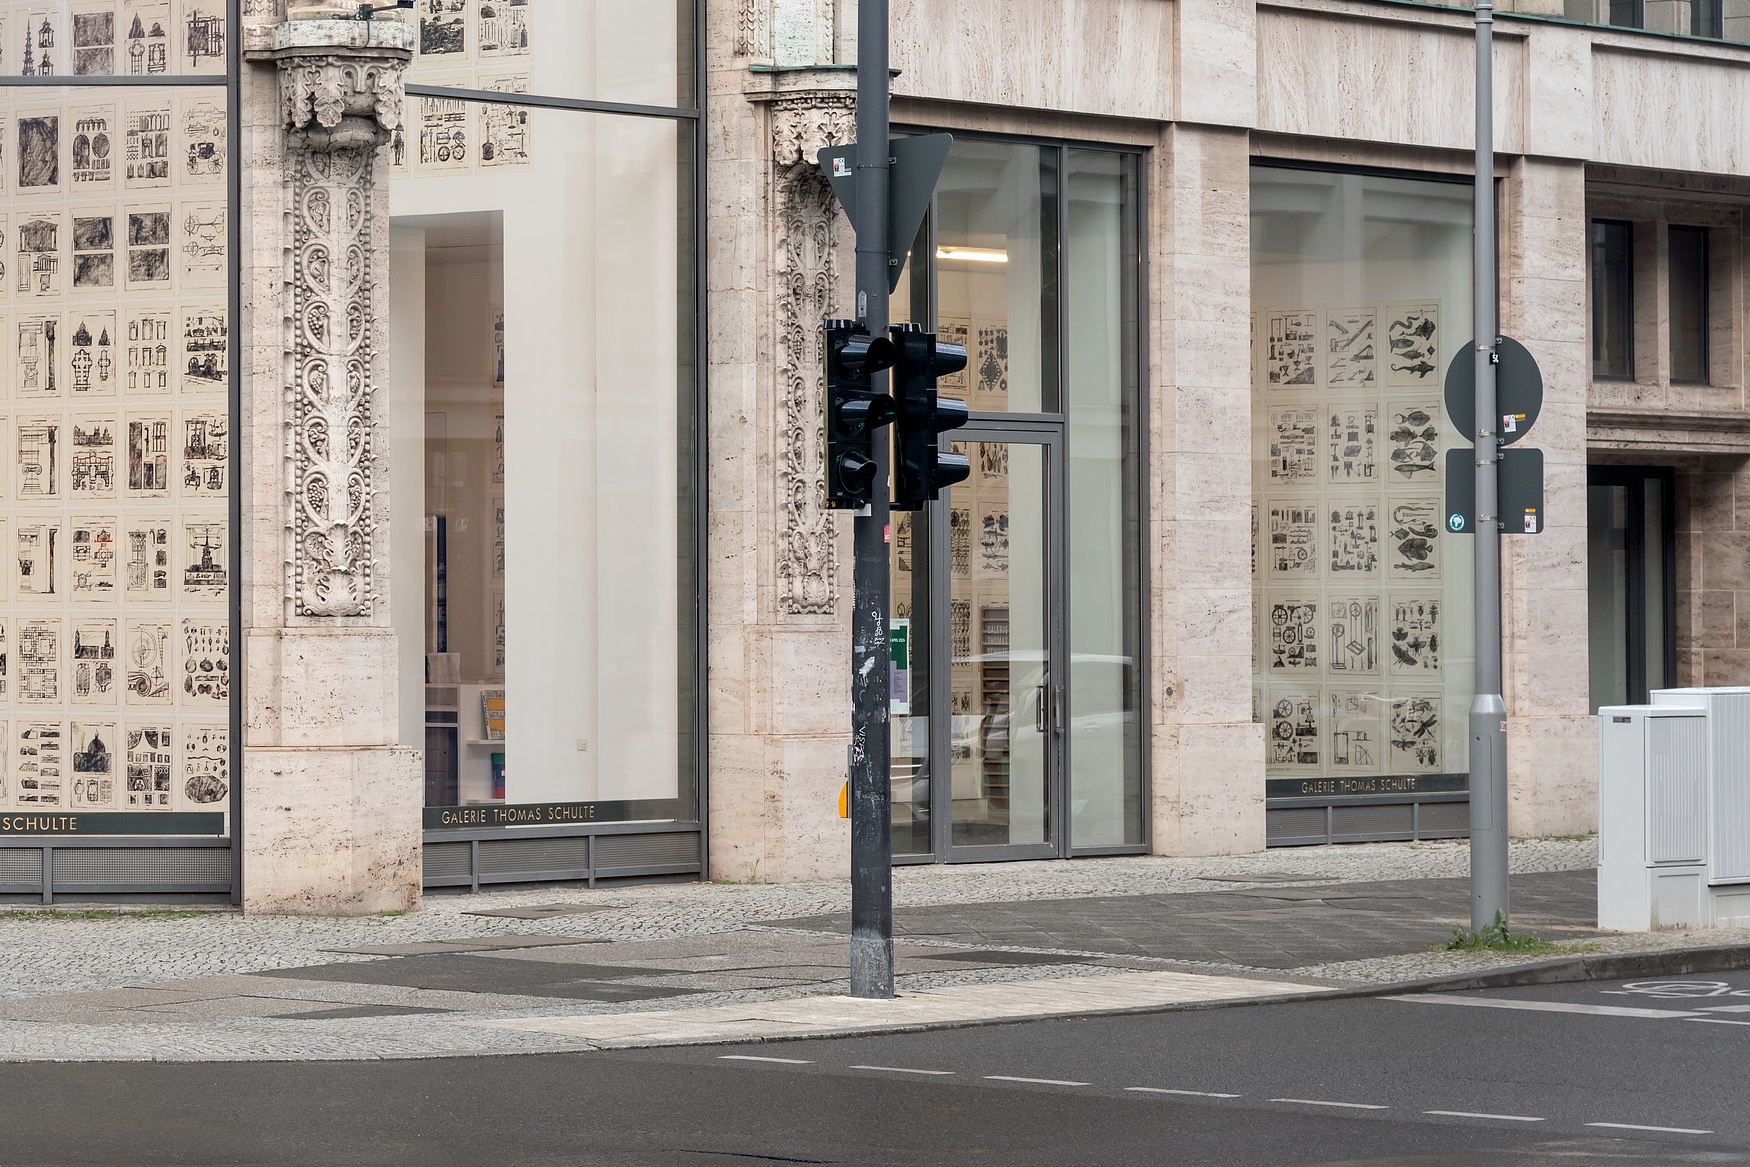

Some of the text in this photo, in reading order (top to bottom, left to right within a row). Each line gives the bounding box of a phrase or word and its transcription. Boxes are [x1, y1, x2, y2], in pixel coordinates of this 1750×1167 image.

[1301, 778, 1416, 794] GALERIE THOMAS SCHULTE
[441, 805, 595, 824] GALERIE THOMAS SCHULTE
[2, 817, 78, 831] SCHULTE
